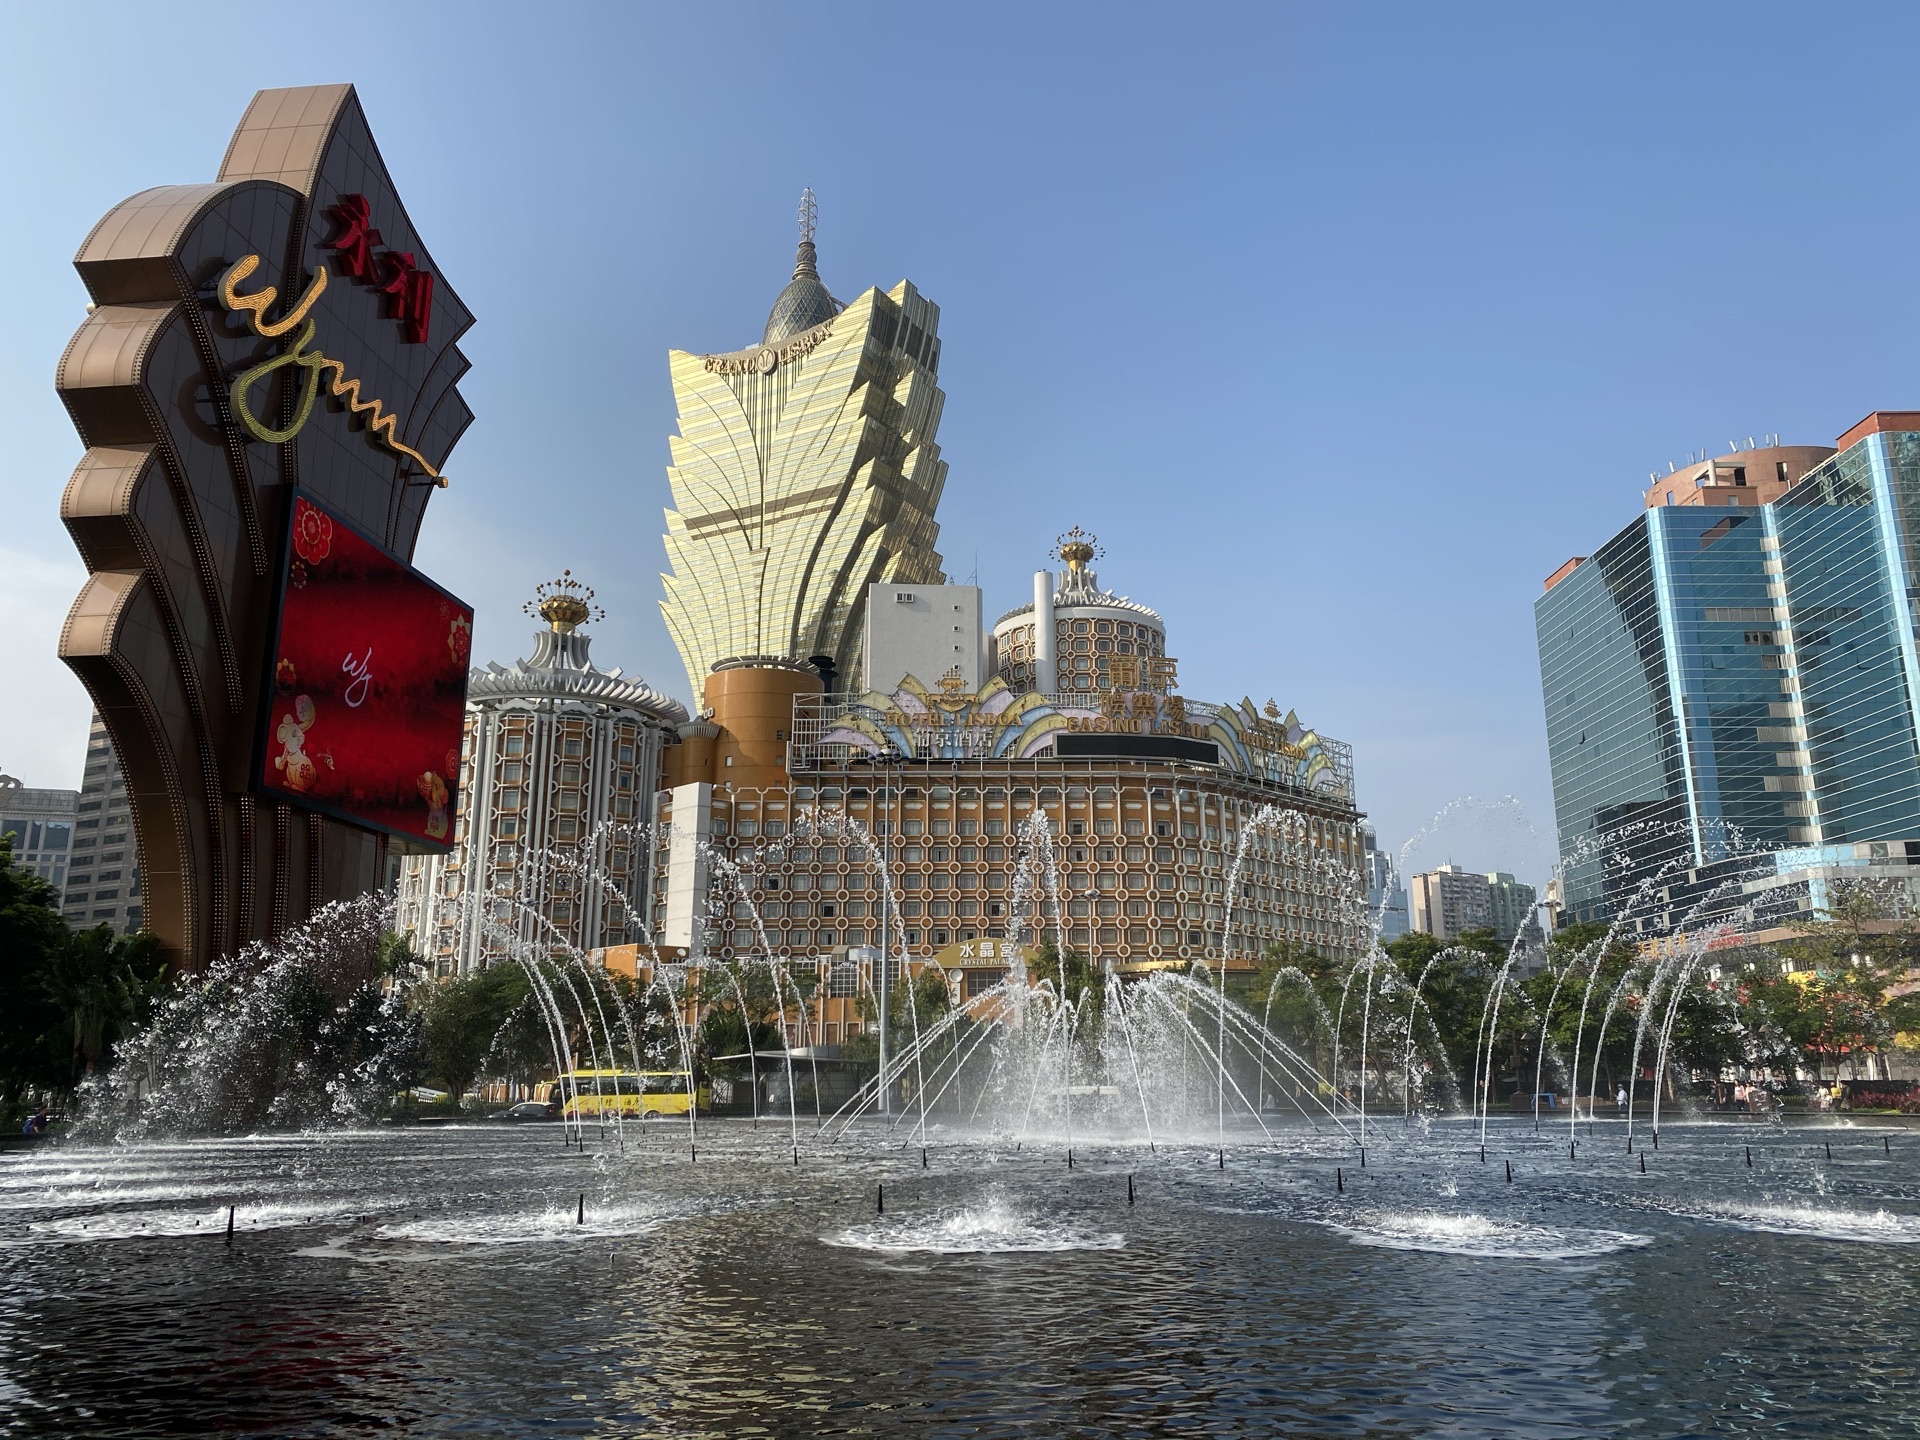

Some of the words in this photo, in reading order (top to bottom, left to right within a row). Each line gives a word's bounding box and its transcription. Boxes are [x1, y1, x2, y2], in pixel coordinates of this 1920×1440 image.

[331, 193, 434, 343] 永利
[703, 357, 756, 375] GRAND
[777, 324, 833, 363] LISBOA
[1107, 654, 1179, 689] 葡京
[885, 712, 949, 727] HOTEL
[956, 712, 1023, 727] LISBOA
[1066, 716, 1142, 735] CASINO
[1149, 718, 1211, 741] LISBOA
[913, 728, 993, 748] 葡京酒店
[960, 958, 988, 966] CRYSTAL
